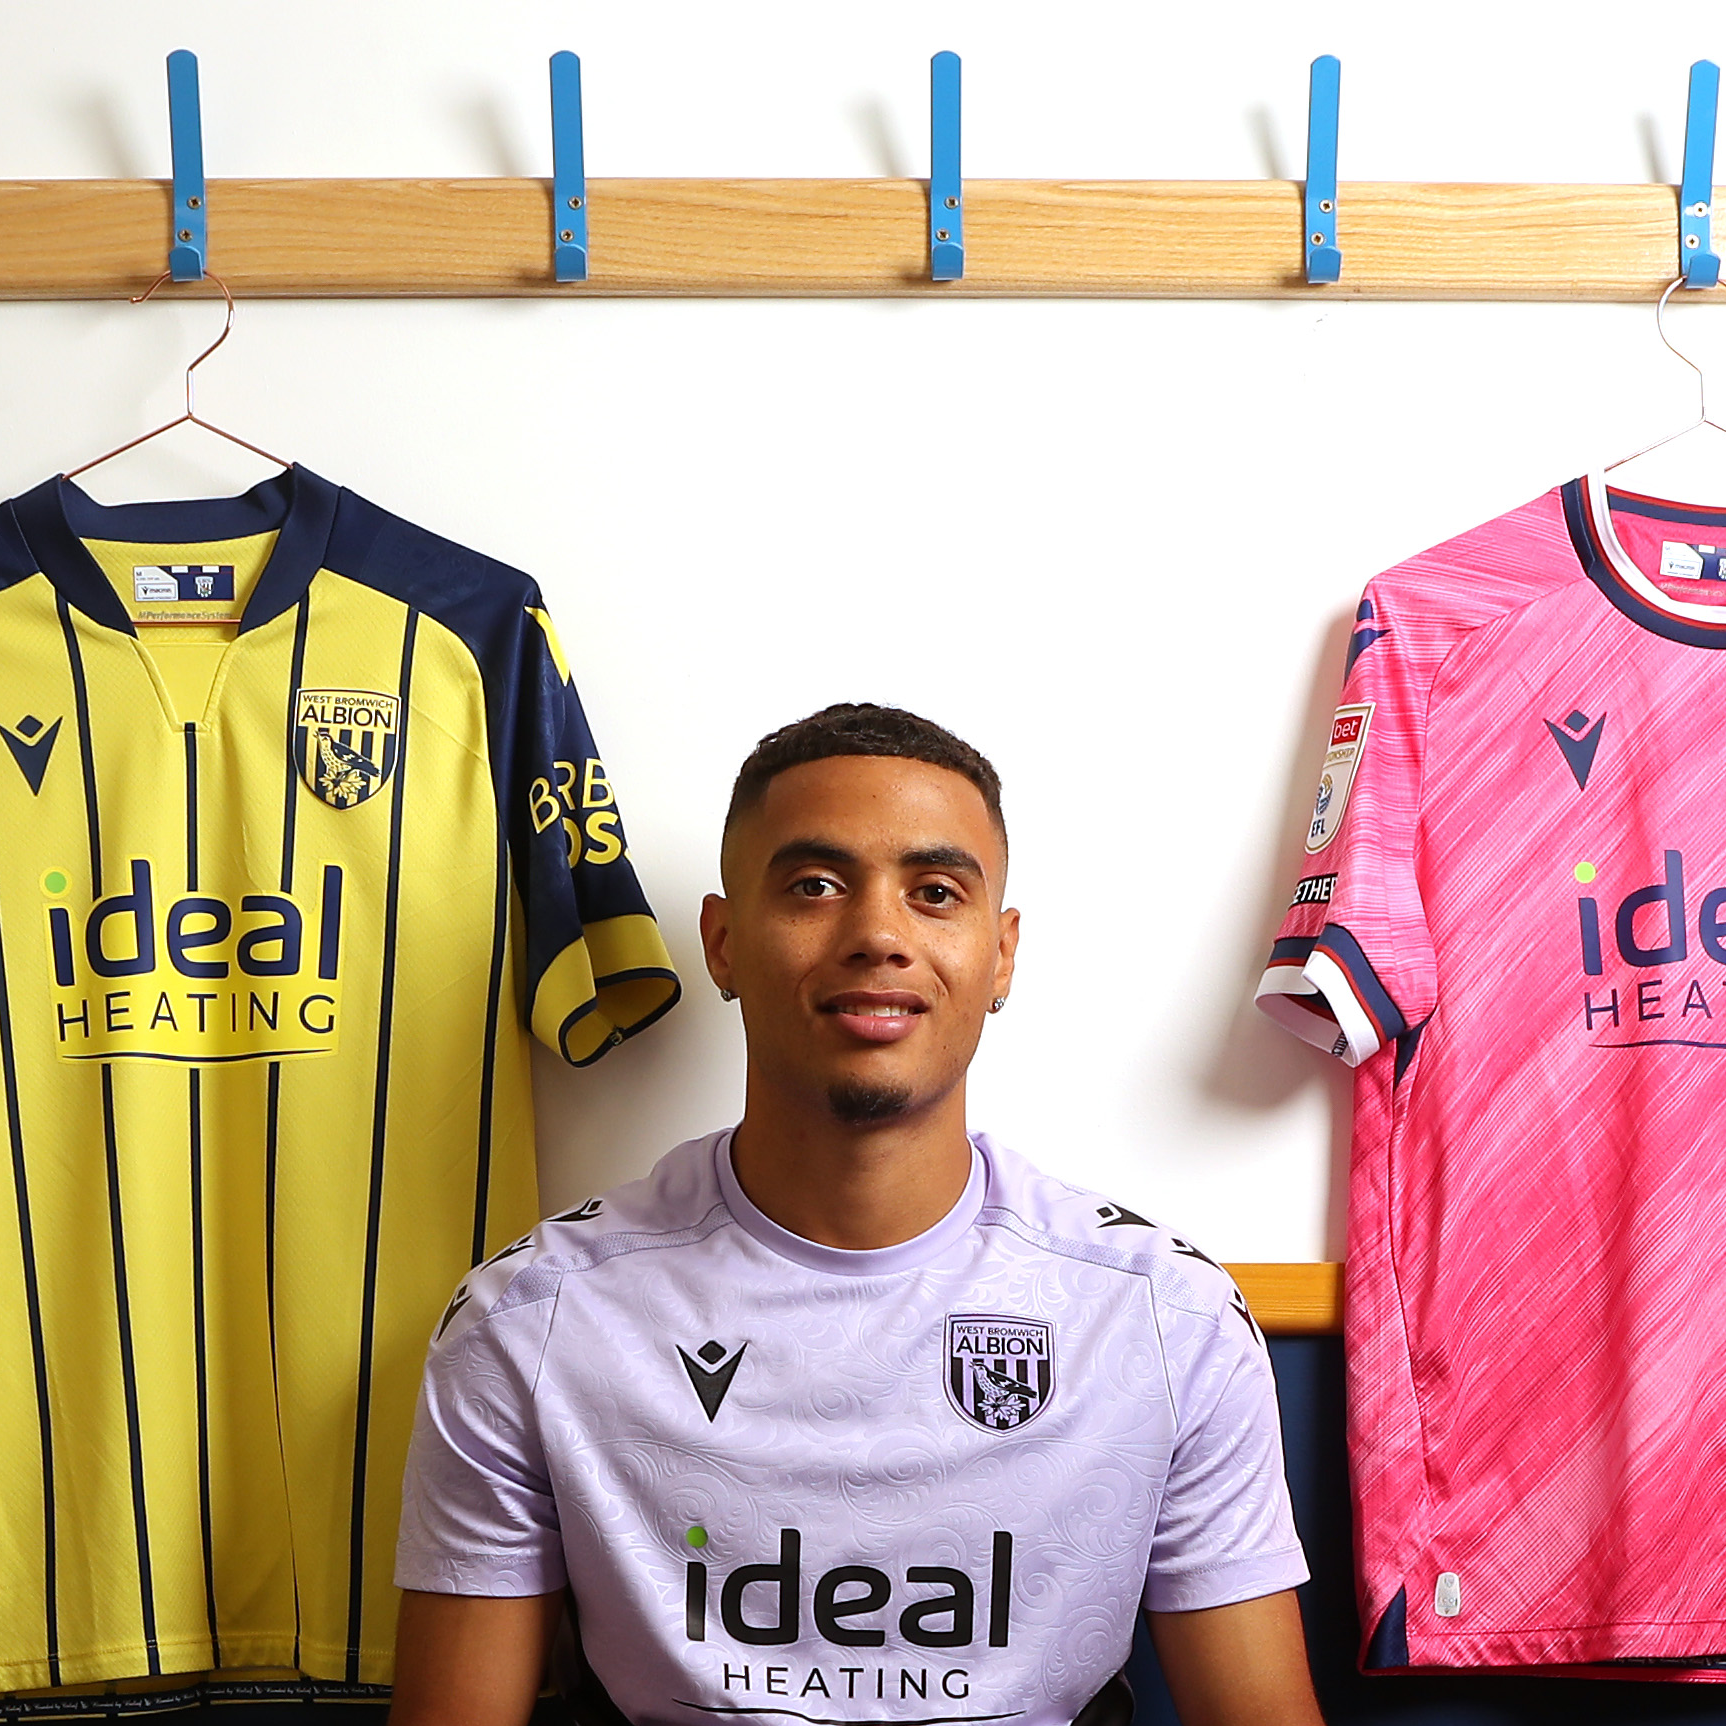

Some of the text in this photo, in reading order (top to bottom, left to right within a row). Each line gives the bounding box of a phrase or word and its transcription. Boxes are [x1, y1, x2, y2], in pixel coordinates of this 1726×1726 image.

[303, 694, 393, 709] WEST BROMWICH
[301, 704, 392, 729] ALBION
[1334, 719, 1359, 739] bet
[1311, 818, 1325, 837] EFL
[43, 859, 342, 986] ideal
[57, 991, 336, 1042] HEATING
[956, 1325, 1043, 1337] WEST BROMWICH
[956, 1335, 1044, 1355] ALBION
[685, 1525, 1013, 1648] ideal
[723, 1663, 971, 1700] HEATING
